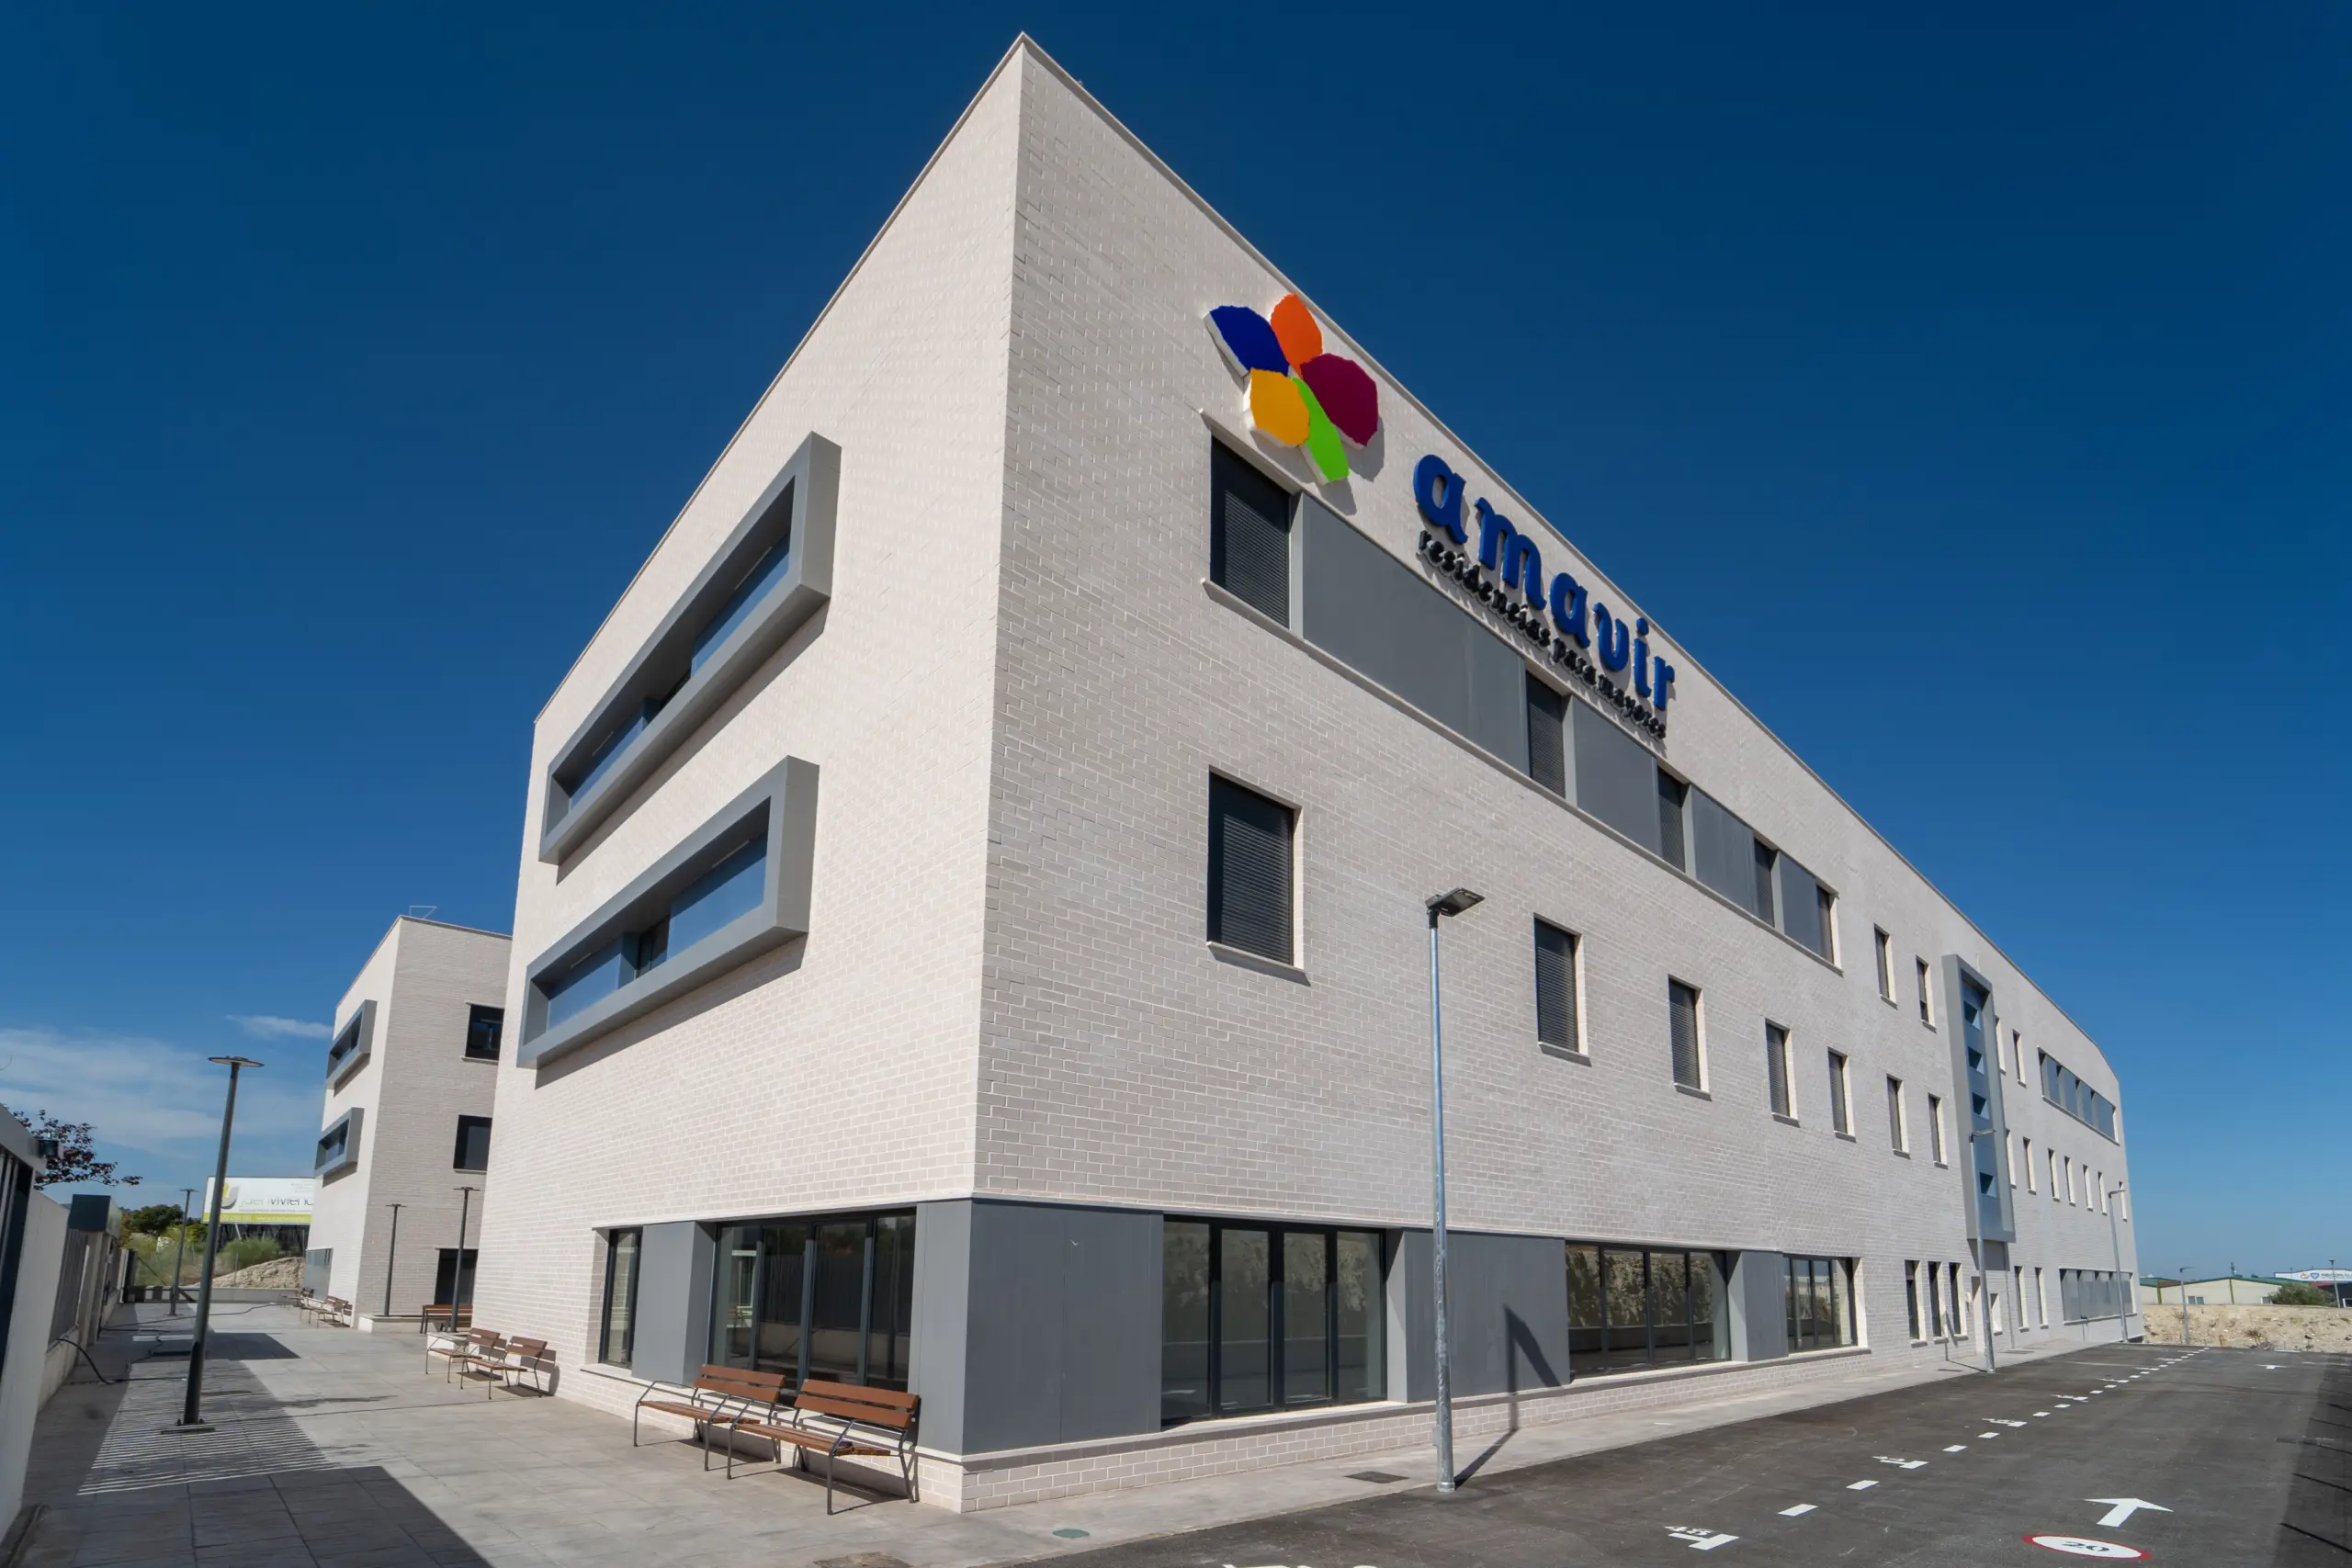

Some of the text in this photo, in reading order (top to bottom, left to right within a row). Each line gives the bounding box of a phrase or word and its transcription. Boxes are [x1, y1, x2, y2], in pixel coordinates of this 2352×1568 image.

[1413, 454, 1675, 711] amavir
[1419, 530, 1667, 739] residencias para mayores
[2061, 1540, 2110, 1552] 20
